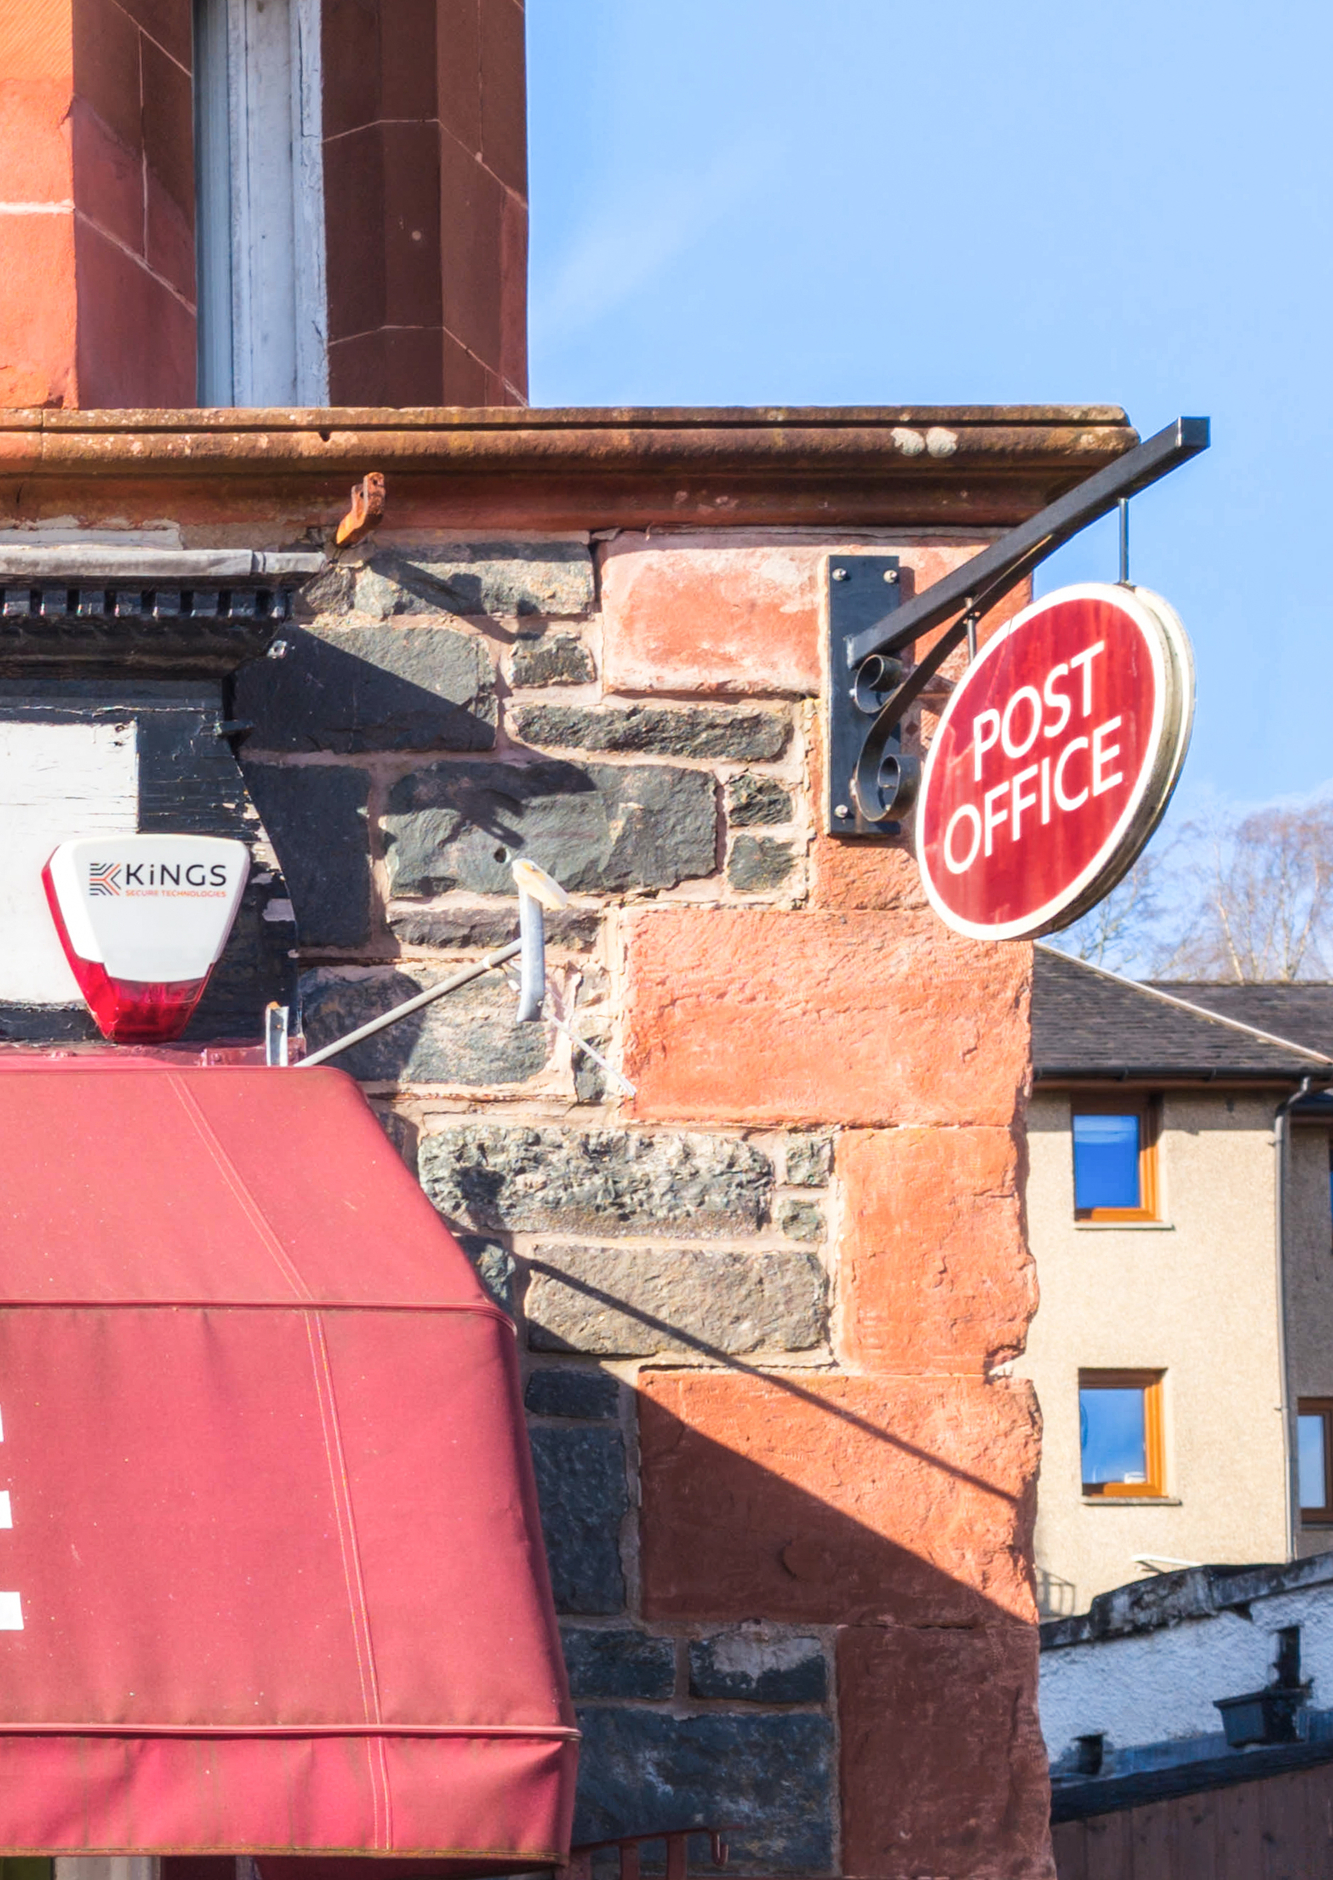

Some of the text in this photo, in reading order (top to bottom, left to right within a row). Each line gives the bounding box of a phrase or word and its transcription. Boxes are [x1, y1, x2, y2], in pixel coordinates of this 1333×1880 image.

[973, 641, 1105, 782] POST
[944, 716, 1123, 875] OFFICE
[125, 889, 227, 898] SECURE TECHNOLOGIES
